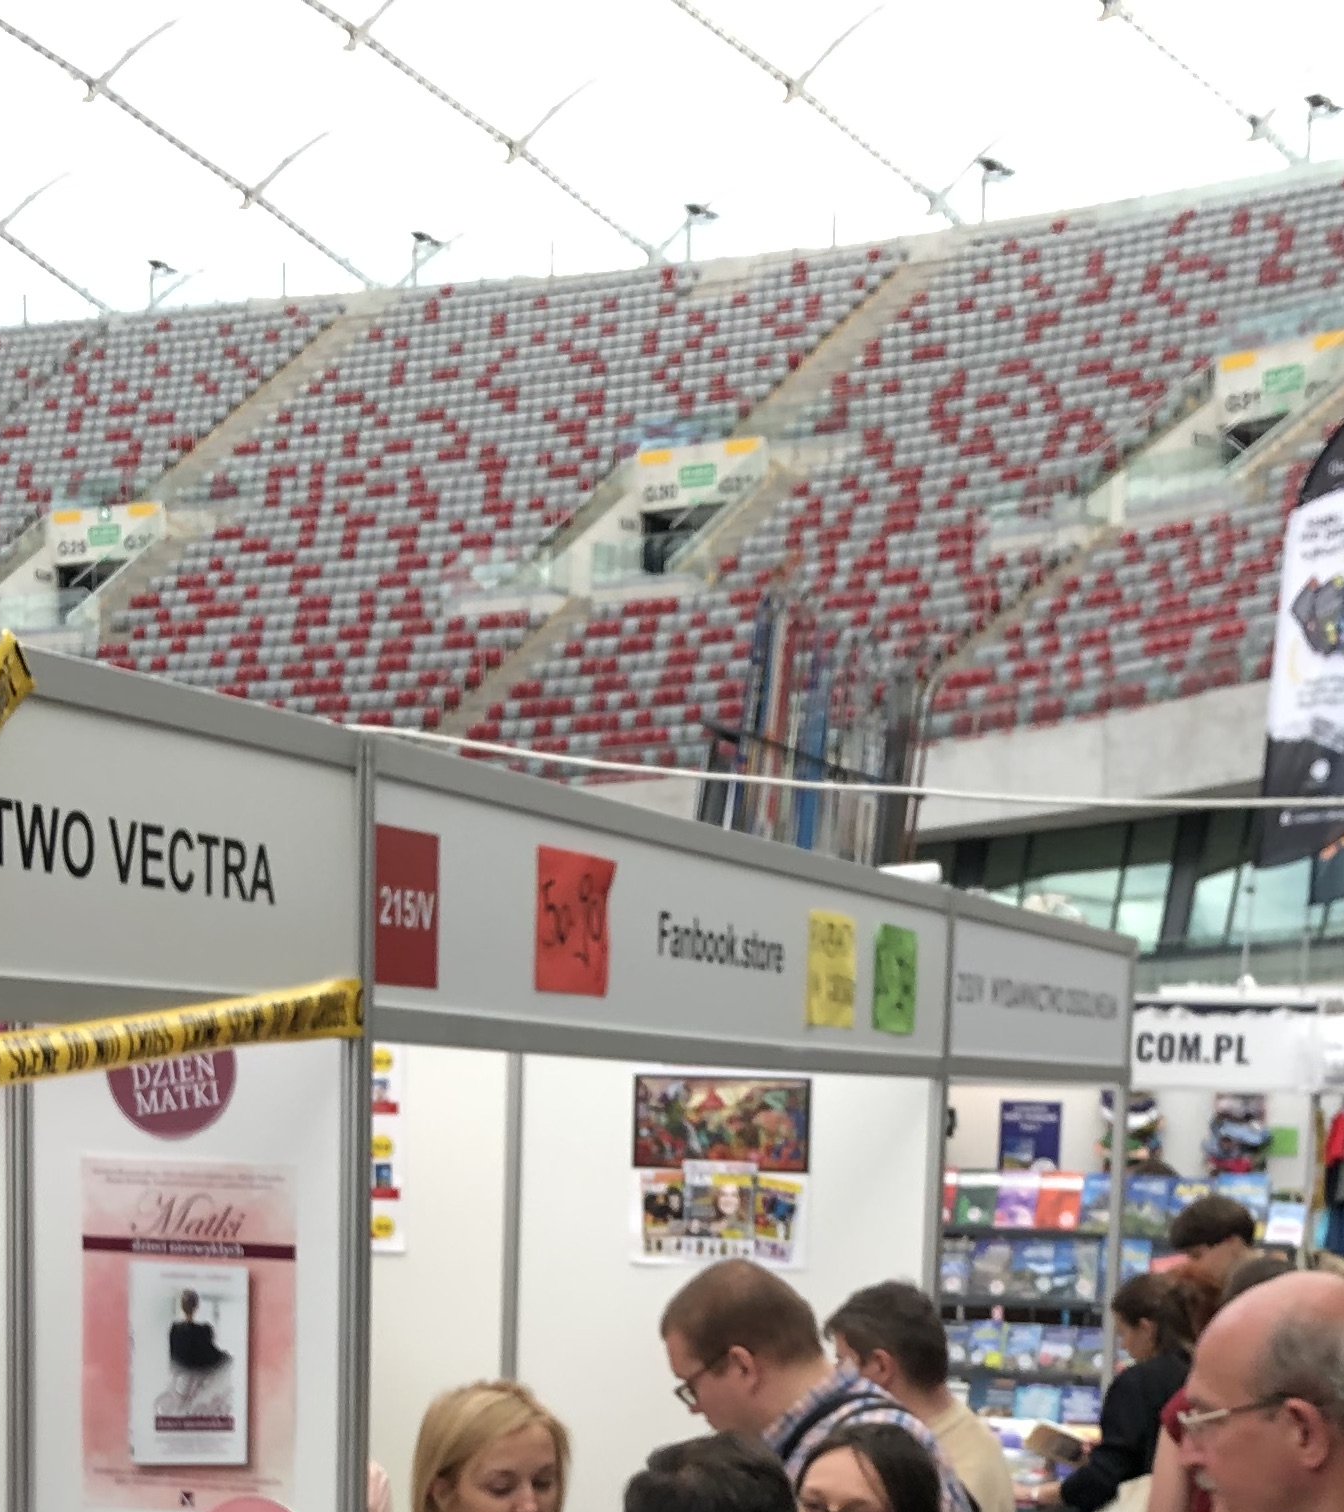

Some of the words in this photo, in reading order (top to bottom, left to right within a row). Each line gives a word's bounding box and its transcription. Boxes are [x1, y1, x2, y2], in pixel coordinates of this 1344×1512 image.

[109, 815, 276, 906] VECTRA
[657, 910, 786, 974] Fanbook.store
[7, 1032, 56, 1080] SCENE
[60, 1030, 89, 1071] DO
[91, 1025, 120, 1067] NOT
[123, 1016, 174, 1061] CROSS
[1136, 1031, 1251, 1066] COM.PL
[135, 1081, 220, 1117] MATKI
[130, 1192, 246, 1239] Matki
